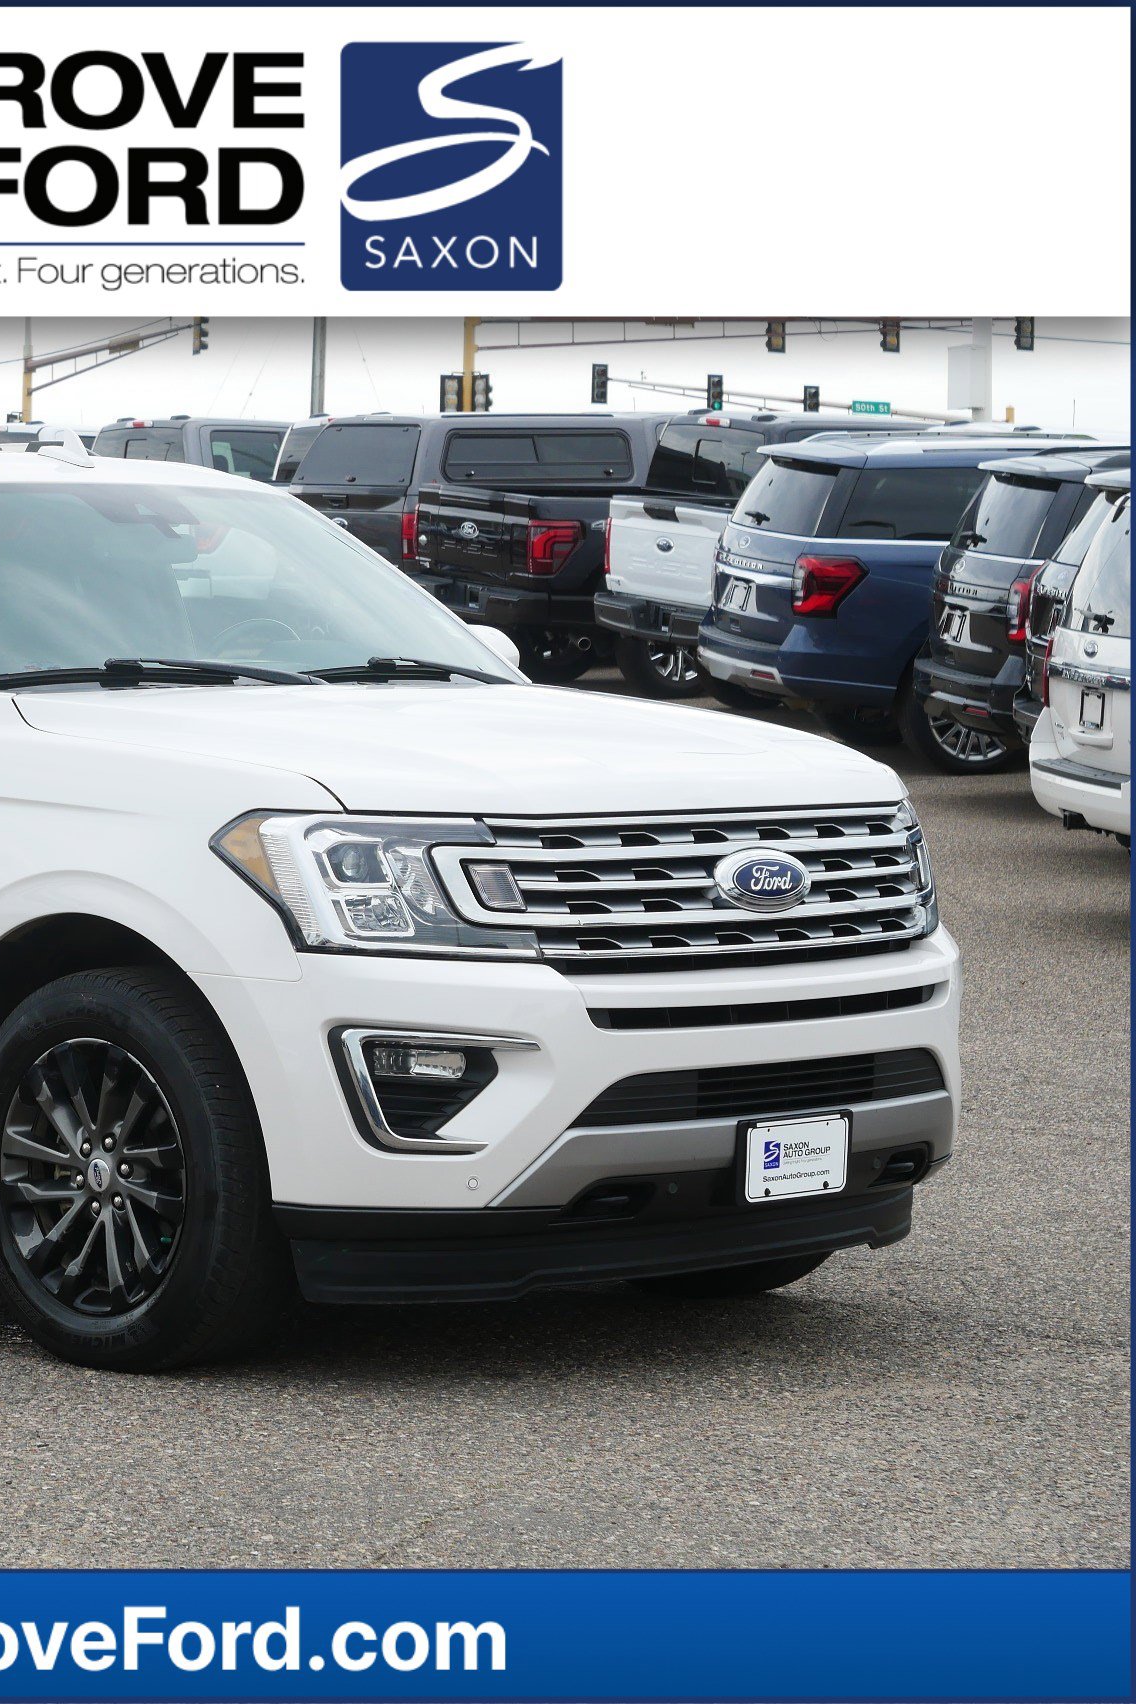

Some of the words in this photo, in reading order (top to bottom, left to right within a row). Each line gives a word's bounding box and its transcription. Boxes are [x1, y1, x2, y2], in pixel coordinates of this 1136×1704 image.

[879, 404, 888, 413] St
[750, 865, 793, 891] Ford
[783, 1141, 810, 1152] SAXON
[783, 1149, 803, 1159] AUTO
[804, 1146, 831, 1156] GROUP
[762, 1169, 830, 1183] SaxonAutoGroup.com
